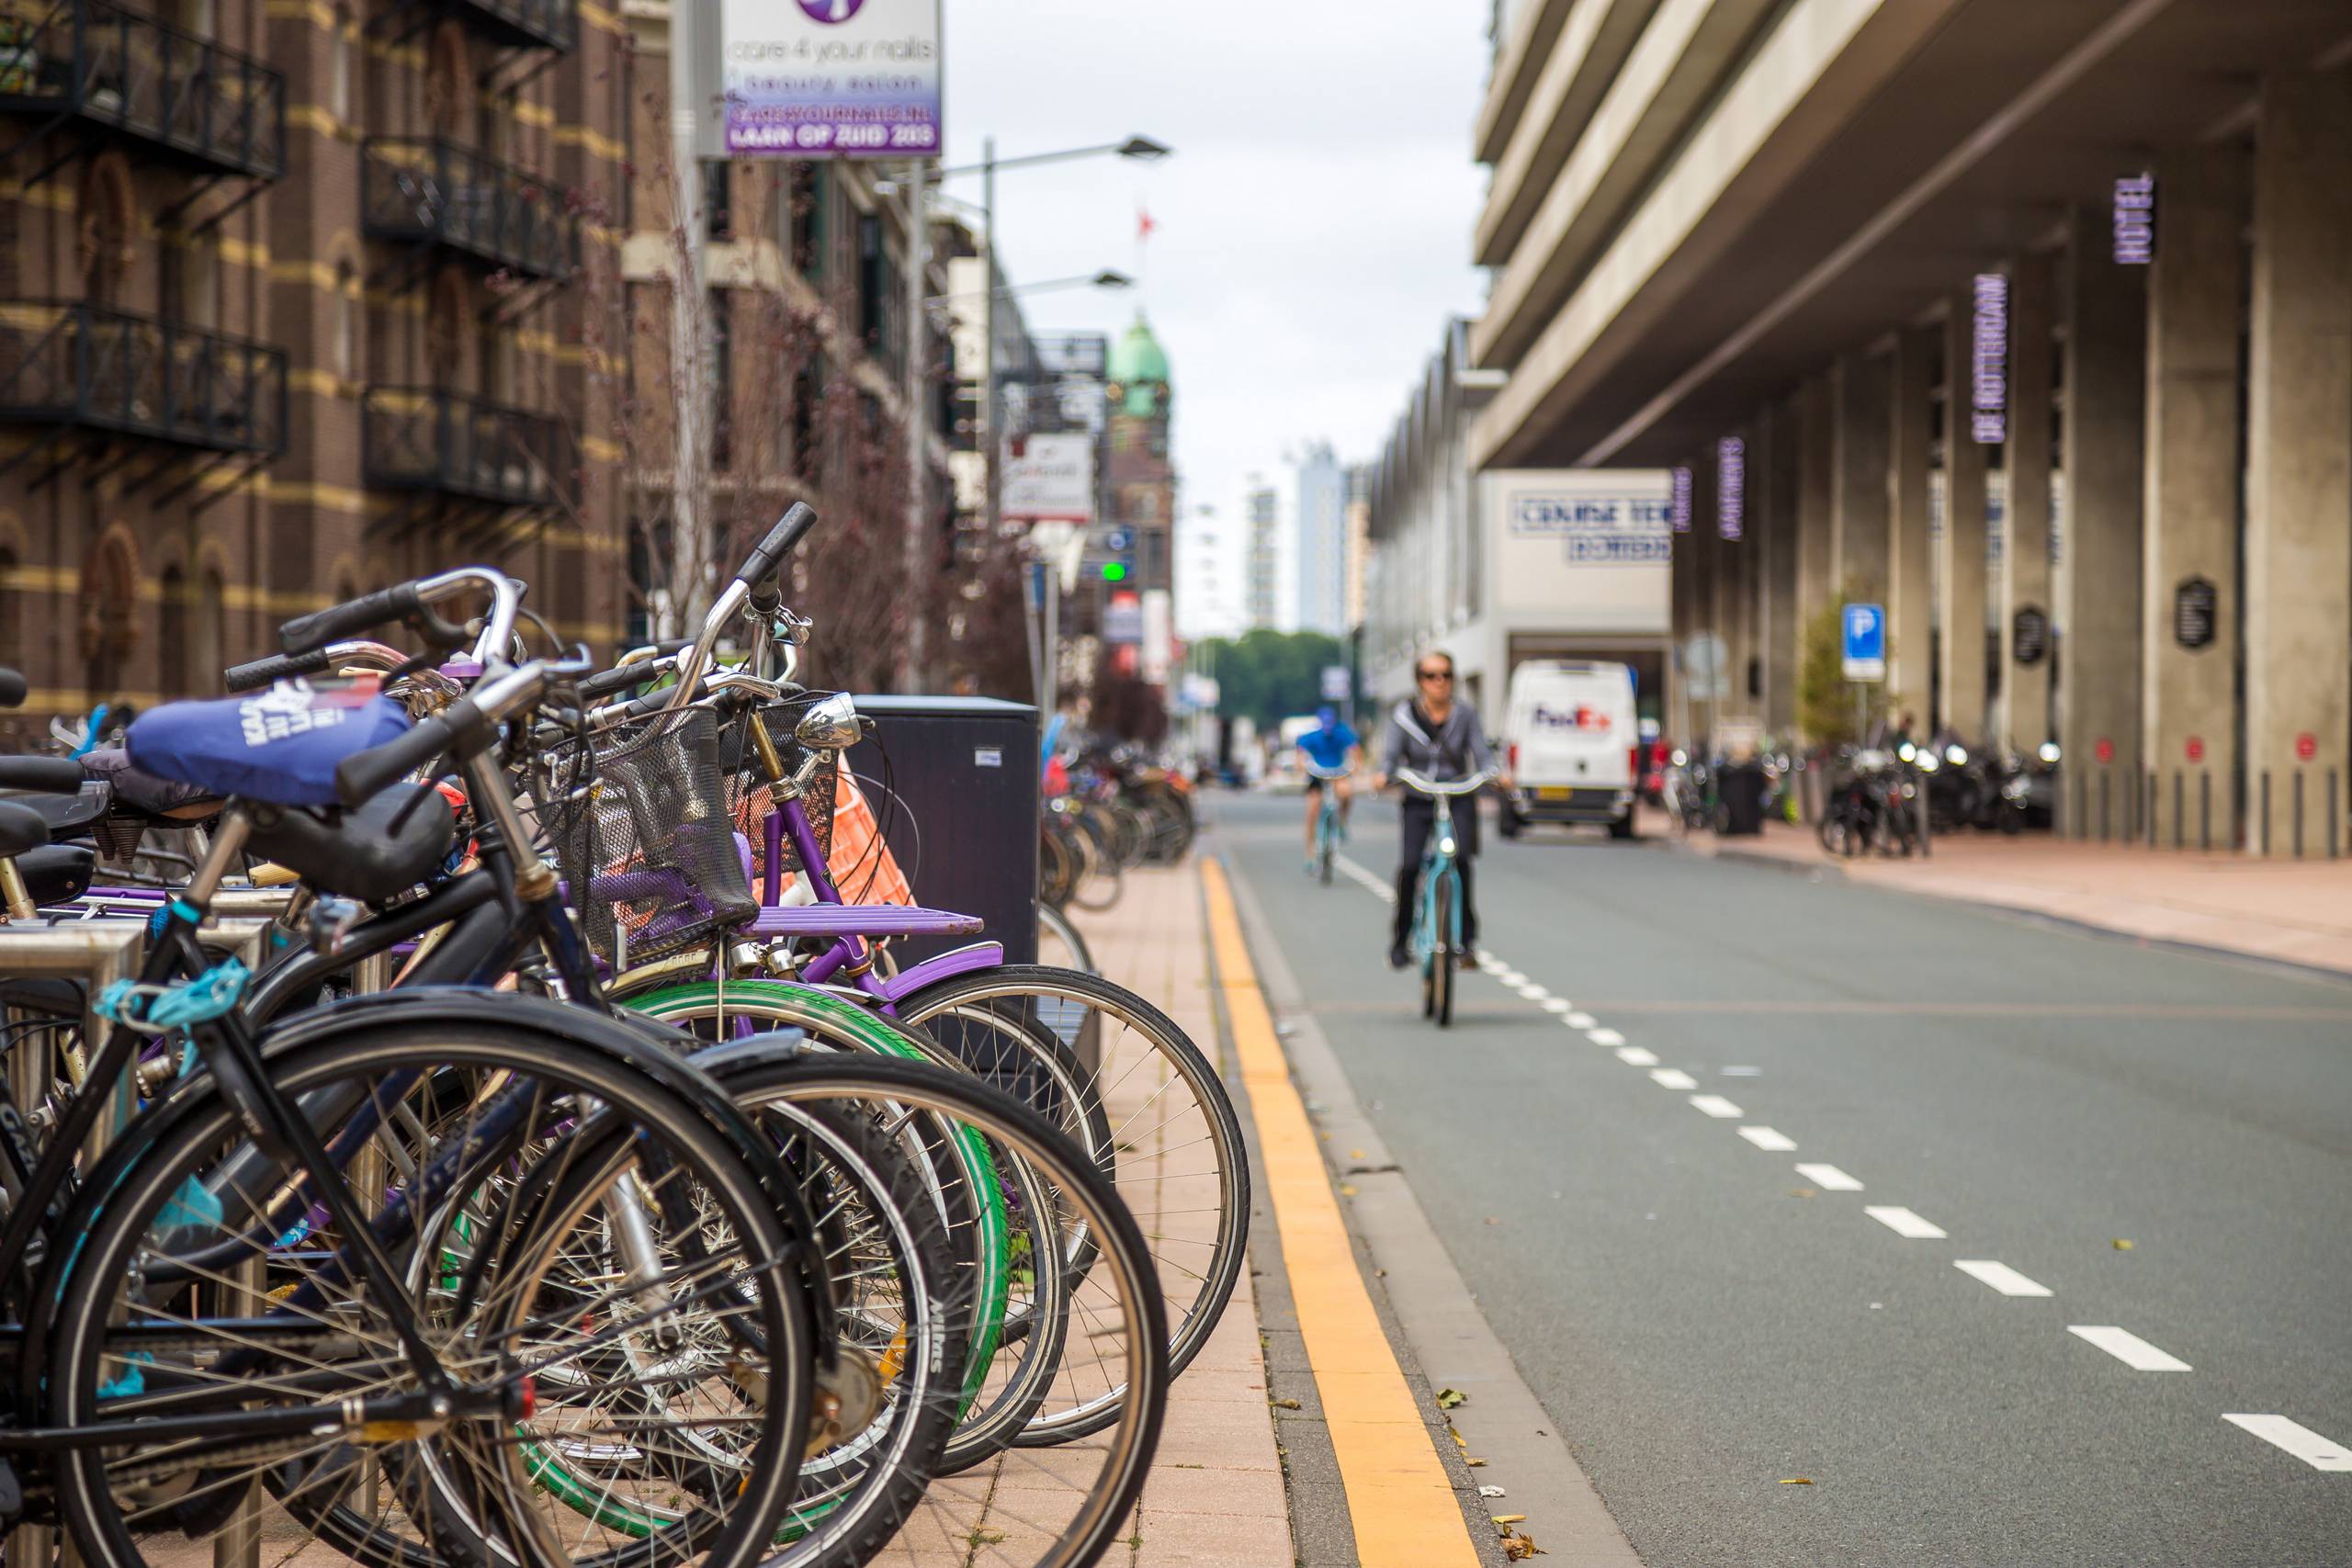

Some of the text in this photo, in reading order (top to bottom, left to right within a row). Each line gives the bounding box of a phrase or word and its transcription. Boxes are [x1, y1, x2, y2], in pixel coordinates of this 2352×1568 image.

[813, 41, 868, 67] your
[875, 38, 937, 62] nails
[729, 124, 795, 148] LAAN
[796, 124, 832, 148] OP
[833, 124, 890, 148] ZUID
[2114, 172, 2153, 264] HOTEL
[1973, 274, 2008, 410] ROTTERDAM
[1517, 499, 1621, 530] CRUISE
[1853, 608, 1877, 639] P
[1534, 704, 1611, 731] FedEx
[928, 1295, 945, 1373] Mitas
